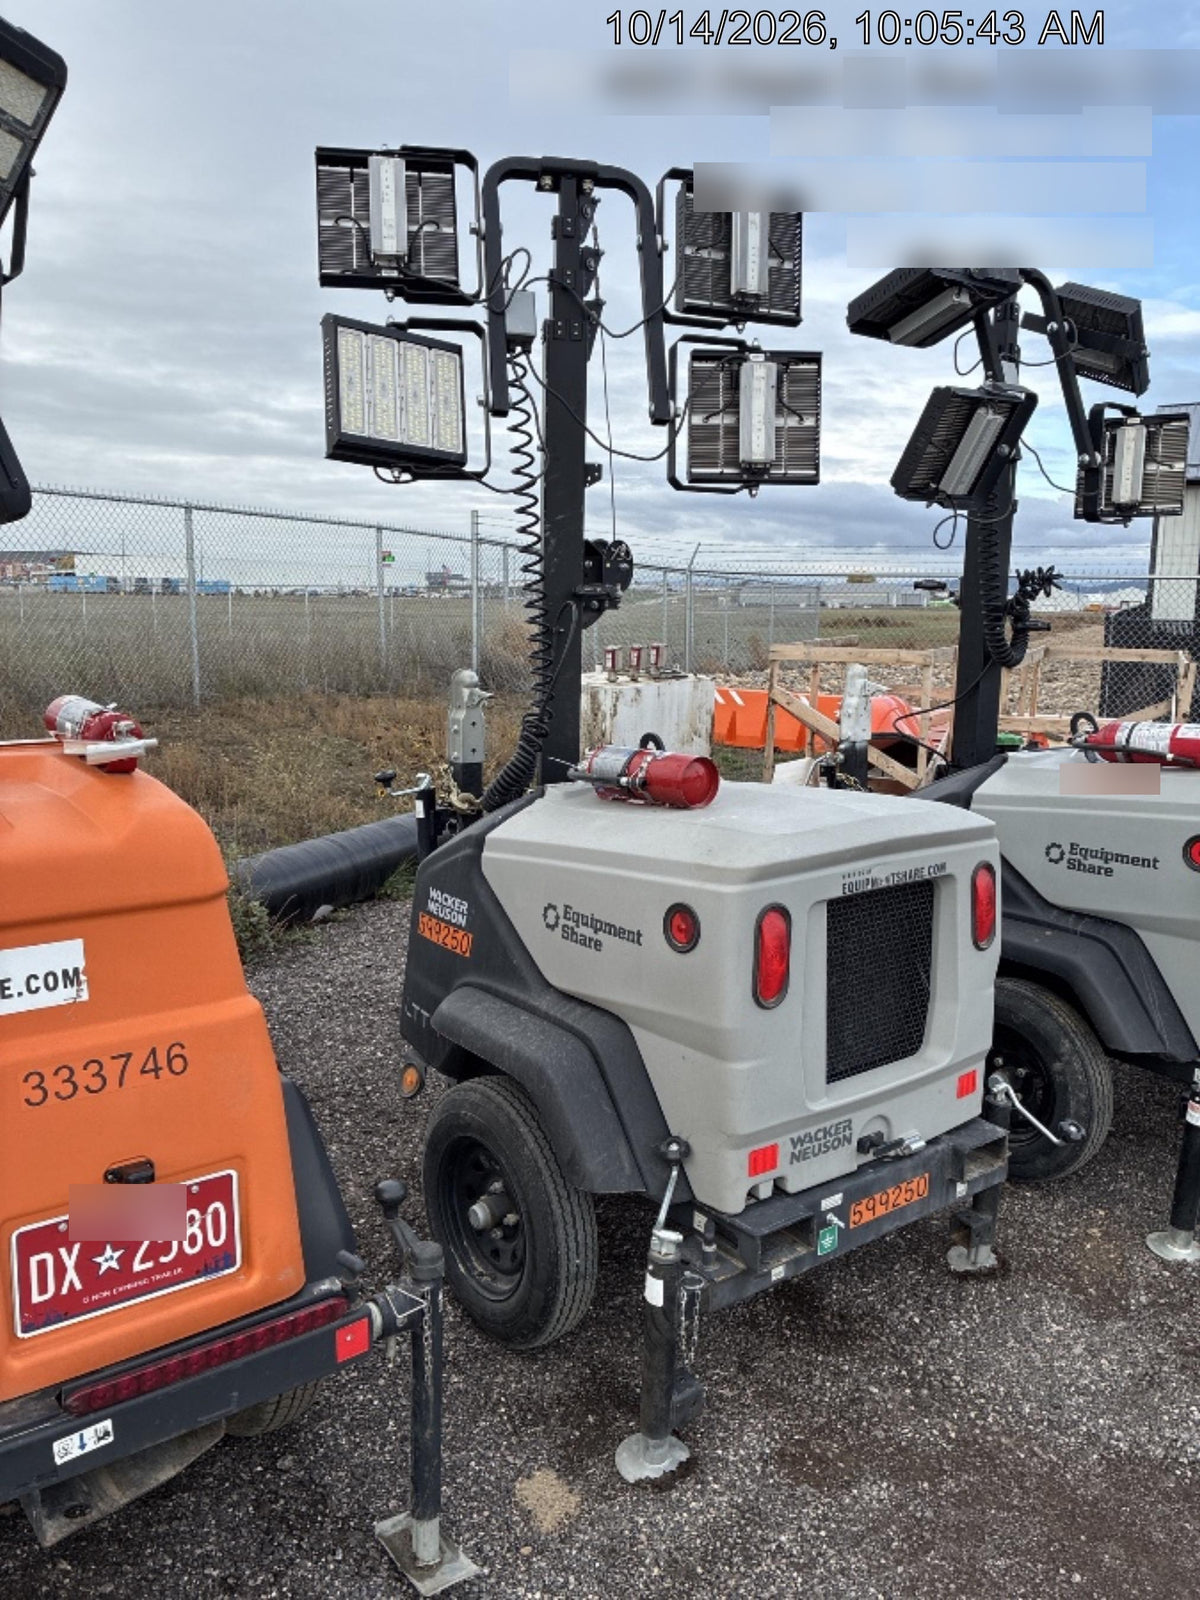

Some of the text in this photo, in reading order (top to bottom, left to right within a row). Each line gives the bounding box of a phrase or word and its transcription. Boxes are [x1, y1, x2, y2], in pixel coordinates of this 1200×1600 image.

[1067, 857, 1114, 877] Share
[1068, 842, 1160, 870] Equipment
[427, 899, 467, 928] NEUSON
[429, 886, 468, 915] WACKER
[420, 913, 470, 954] 599250
[561, 924, 604, 952] Share
[562, 904, 643, 947] Equipment
[22, 1042, 189, 1107] 333746
[789, 1118, 853, 1150] WACKER
[789, 1133, 853, 1165] NEUSON
[852, 1175, 928, 1226] 599250
[29, 1242, 83, 1305] DX
